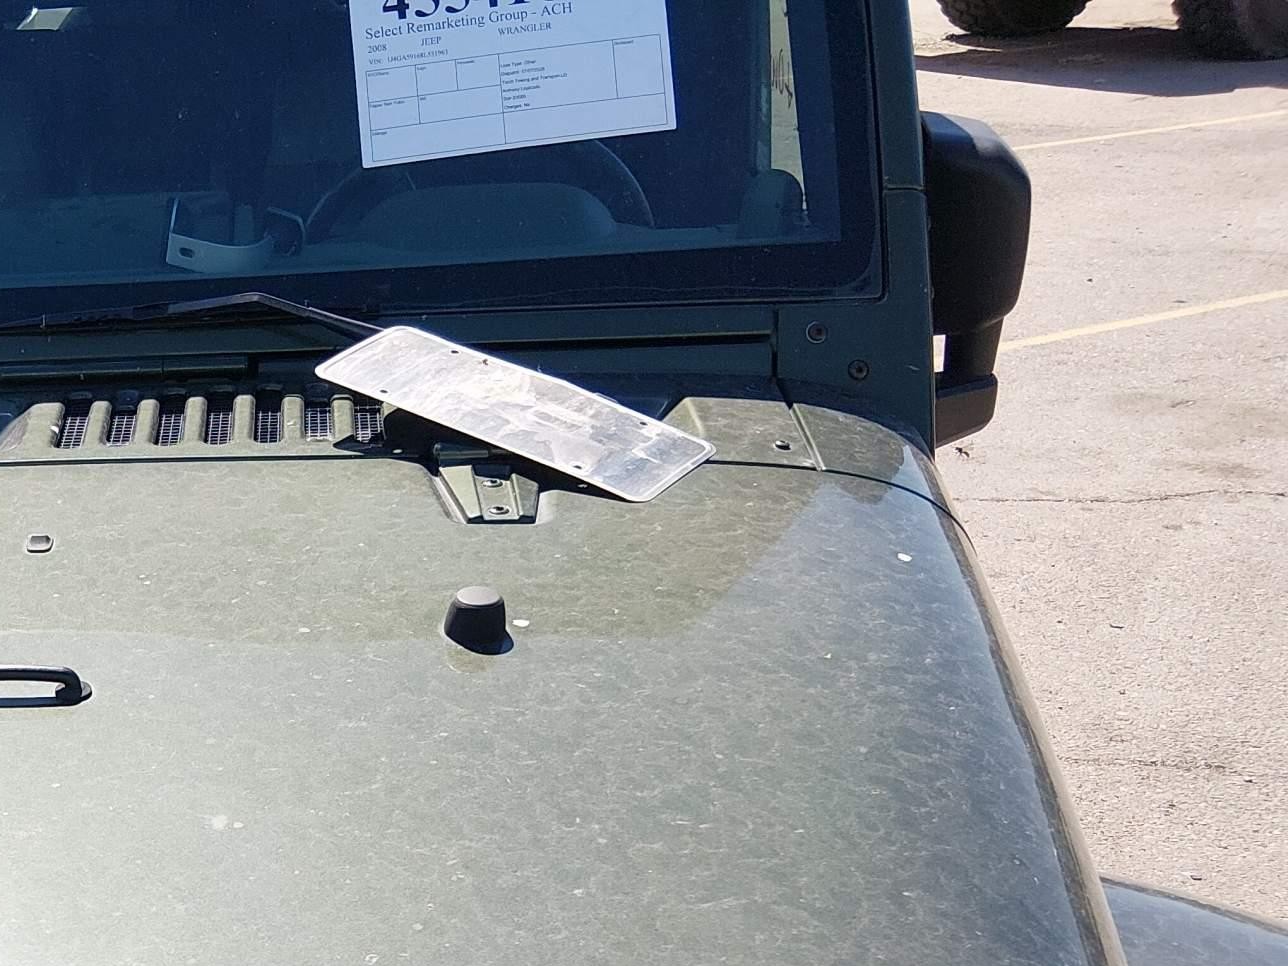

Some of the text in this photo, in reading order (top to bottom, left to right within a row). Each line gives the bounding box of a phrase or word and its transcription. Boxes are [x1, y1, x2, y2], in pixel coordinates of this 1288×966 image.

[364, 24, 403, 40] Select
[406, 13, 486, 33] Remarketing
[488, 10, 529, 23] Group
[540, 2, 573, 17] ACH
[367, 22, 552, 54] 2008 JEEP WRANGLER
